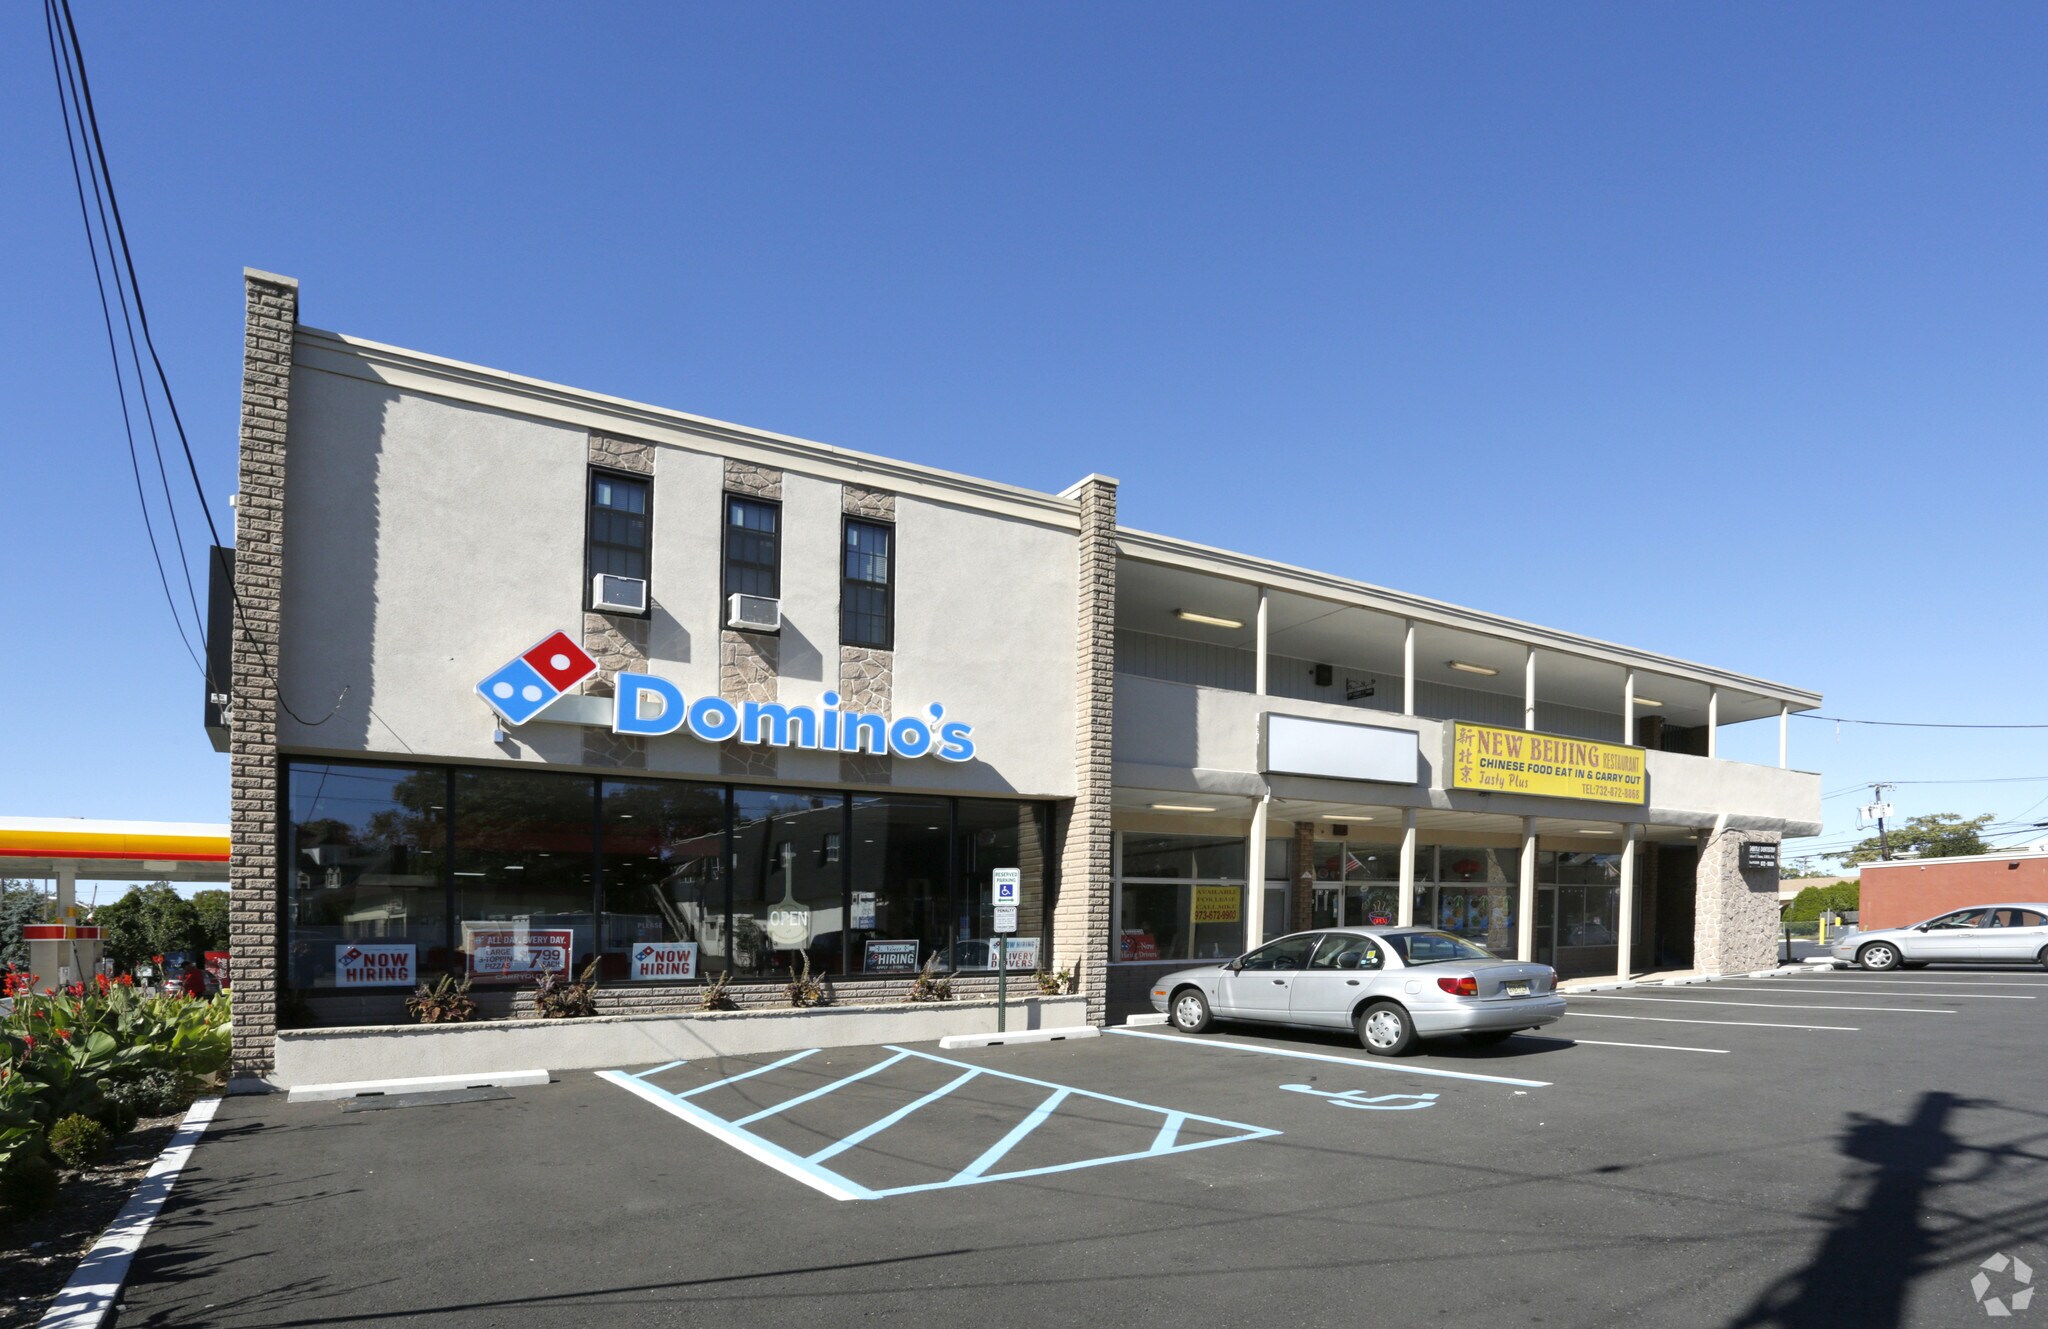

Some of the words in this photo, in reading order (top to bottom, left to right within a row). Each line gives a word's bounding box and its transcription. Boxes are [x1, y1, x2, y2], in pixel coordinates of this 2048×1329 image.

[613, 671, 976, 763] Domino's
[1457, 727, 1475, 783] 新北京
[1477, 730, 1523, 758] NEW
[1530, 737, 1599, 768] BEIJING
[1603, 753, 1639, 772] RESTAURANT
[1480, 758, 1525, 771] CHINESE
[1527, 763, 1552, 775] FOOD
[1555, 766, 1572, 777] EAT
[1575, 768, 1584, 778] IN
[1587, 770, 1593, 779] &
[1595, 772, 1623, 782] CARRY
[1625, 775, 1641, 784] OUT
[1479, 771, 1505, 789] Tasty
[1508, 774, 1528, 788] Plus
[770, 911, 807, 926] OPEN
[1373, 917, 1388, 925] OPEN
[488, 936, 502, 944] ALL
[504, 936, 521, 944] DAY.
[523, 936, 548, 944] EVERY
[550, 936, 566, 944] DAY.
[364, 953, 408, 967] NOW
[655, 950, 691, 962] NOW
[878, 953, 914, 964] HIRING
[346, 967, 409, 982] HIRING
[640, 962, 690, 975] HIRING
